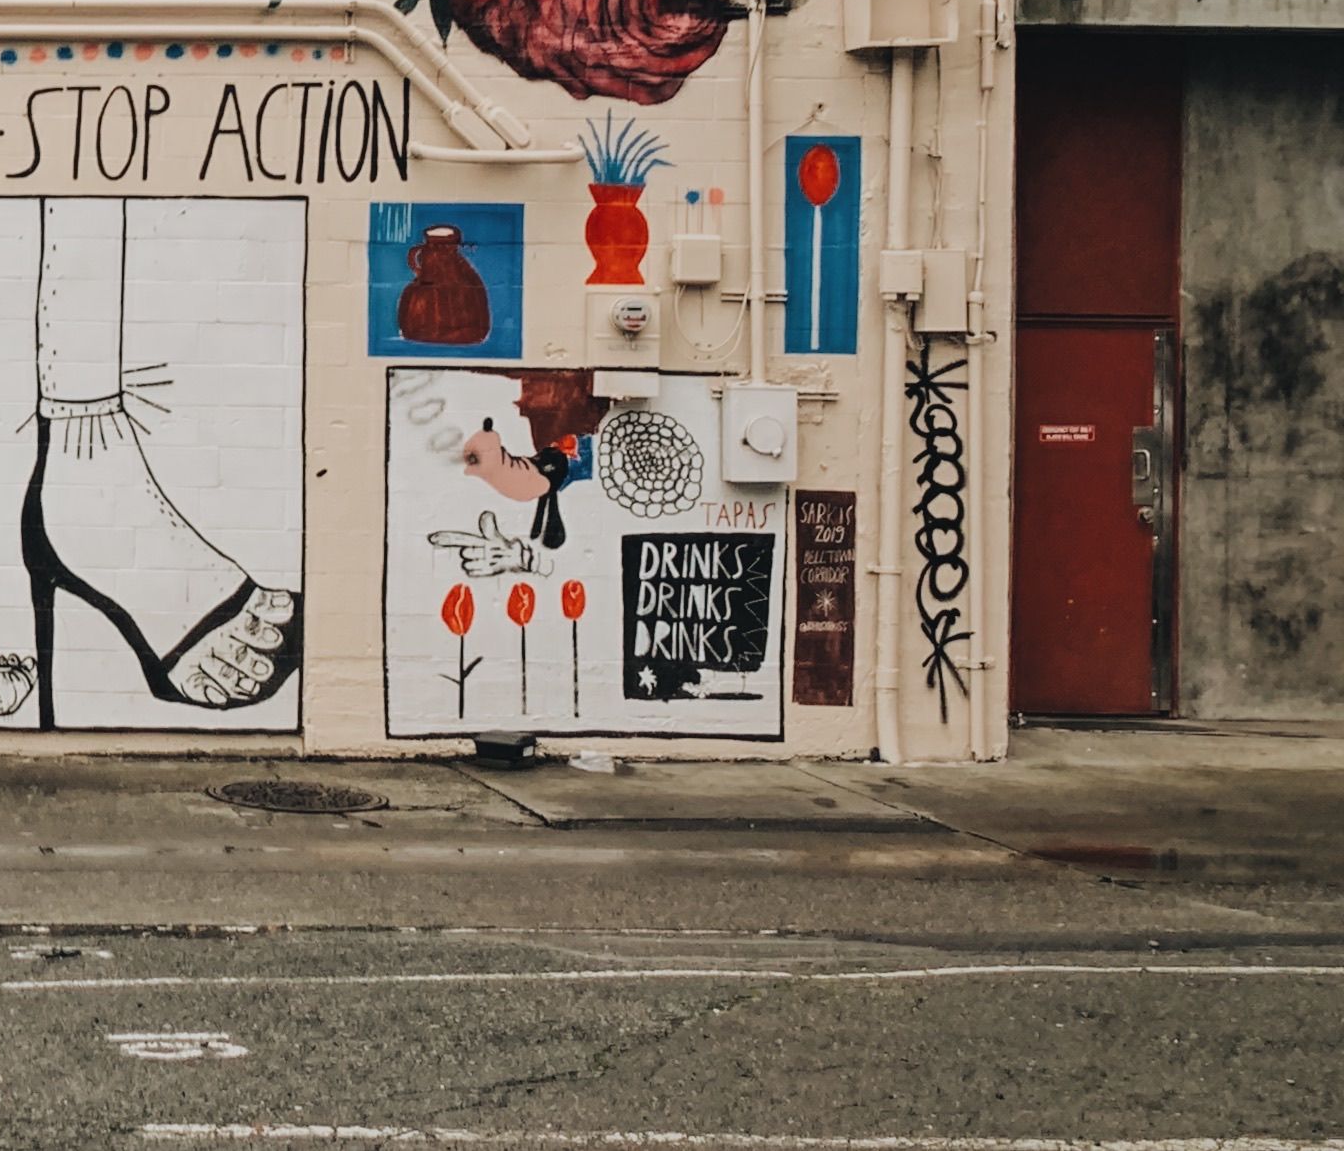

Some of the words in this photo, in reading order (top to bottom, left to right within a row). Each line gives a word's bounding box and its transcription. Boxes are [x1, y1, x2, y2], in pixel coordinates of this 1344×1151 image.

[700, 501, 776, 529] TAPAS
[800, 501, 853, 526] SARKIS
[815, 525, 845, 543] 2019
[639, 541, 748, 580] DRINKS
[636, 581, 742, 623] DRINKS
[634, 620, 738, 663] DRINKS
